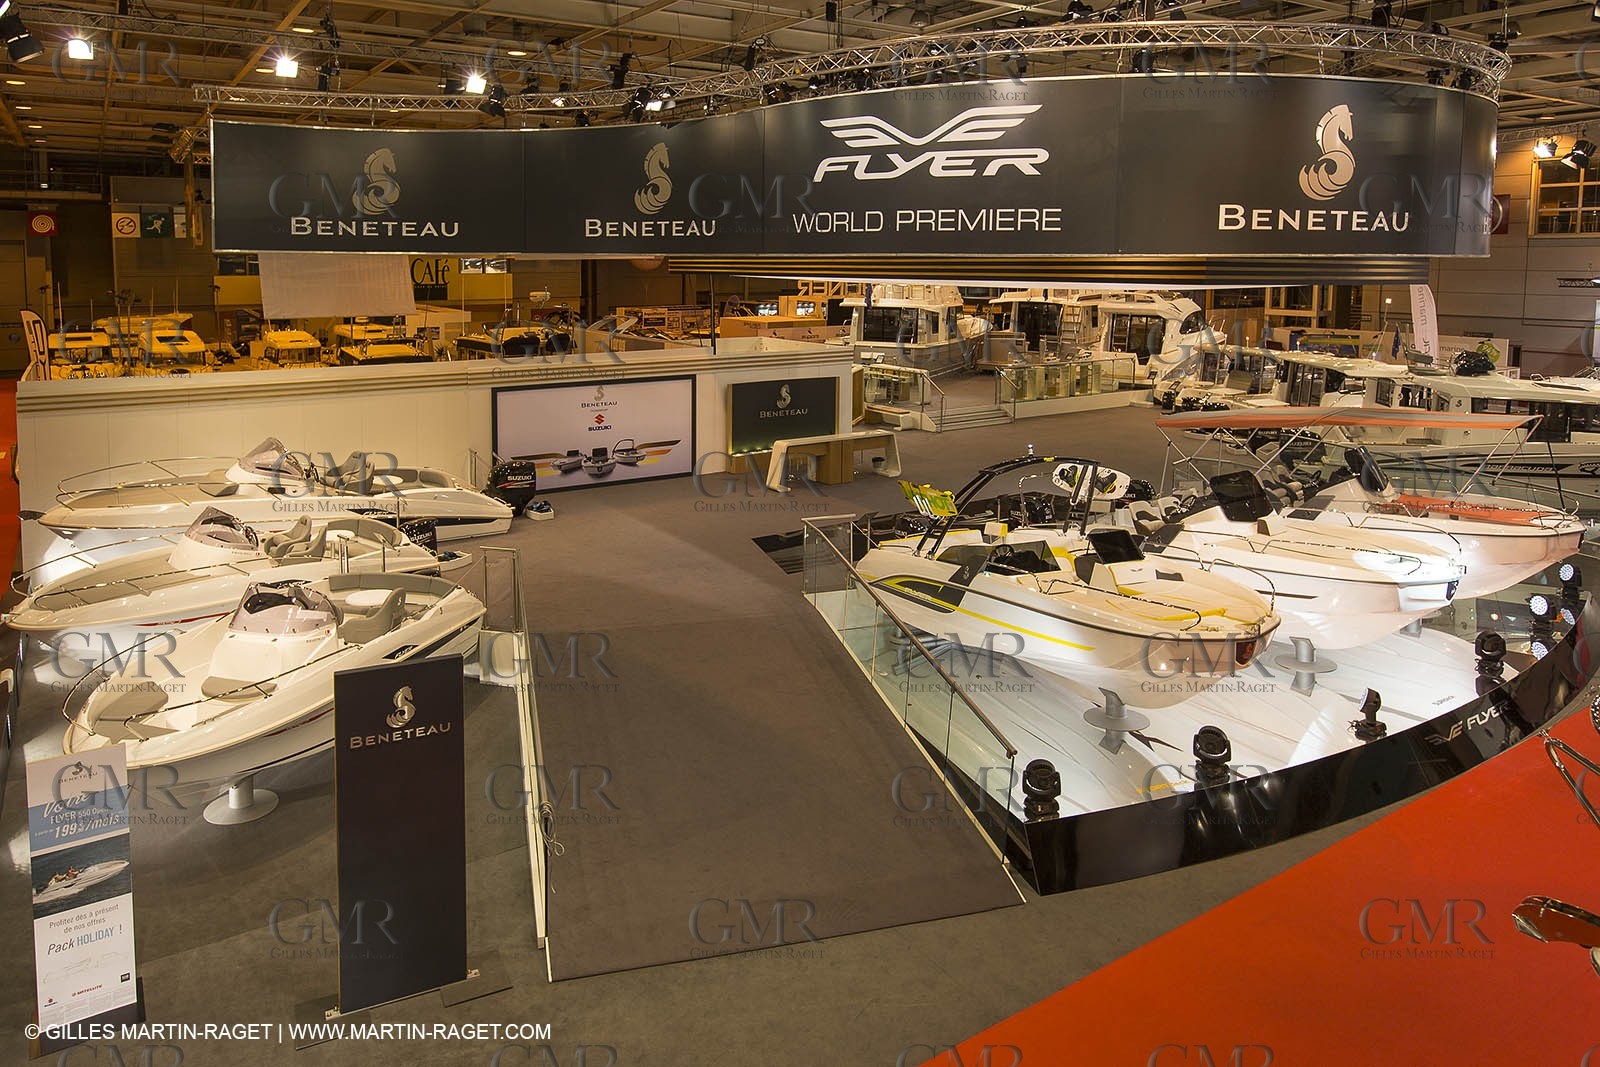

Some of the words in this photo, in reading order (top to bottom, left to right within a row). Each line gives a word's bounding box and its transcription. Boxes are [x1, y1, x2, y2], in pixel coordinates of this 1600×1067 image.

[813, 148, 1049, 182] FLYER
[291, 216, 459, 237] BENETEAU
[585, 218, 716, 237] BENETEAU
[793, 211, 883, 233] WORLD
[896, 208, 1062, 232] PREMIERE
[1218, 204, 1409, 232] BENETEAU
[759, 408, 808, 419] BENETEAU
[350, 721, 451, 749] BENETEAU
[50, 812, 76, 825] FLYER
[49, 917, 74, 929] Profitez
[63, 925, 73, 934] de
[74, 922, 86, 931] nos
[87, 917, 107, 927] offres
[47, 938, 75, 956] Pack
[76, 926, 115, 947] HOLIDAY
